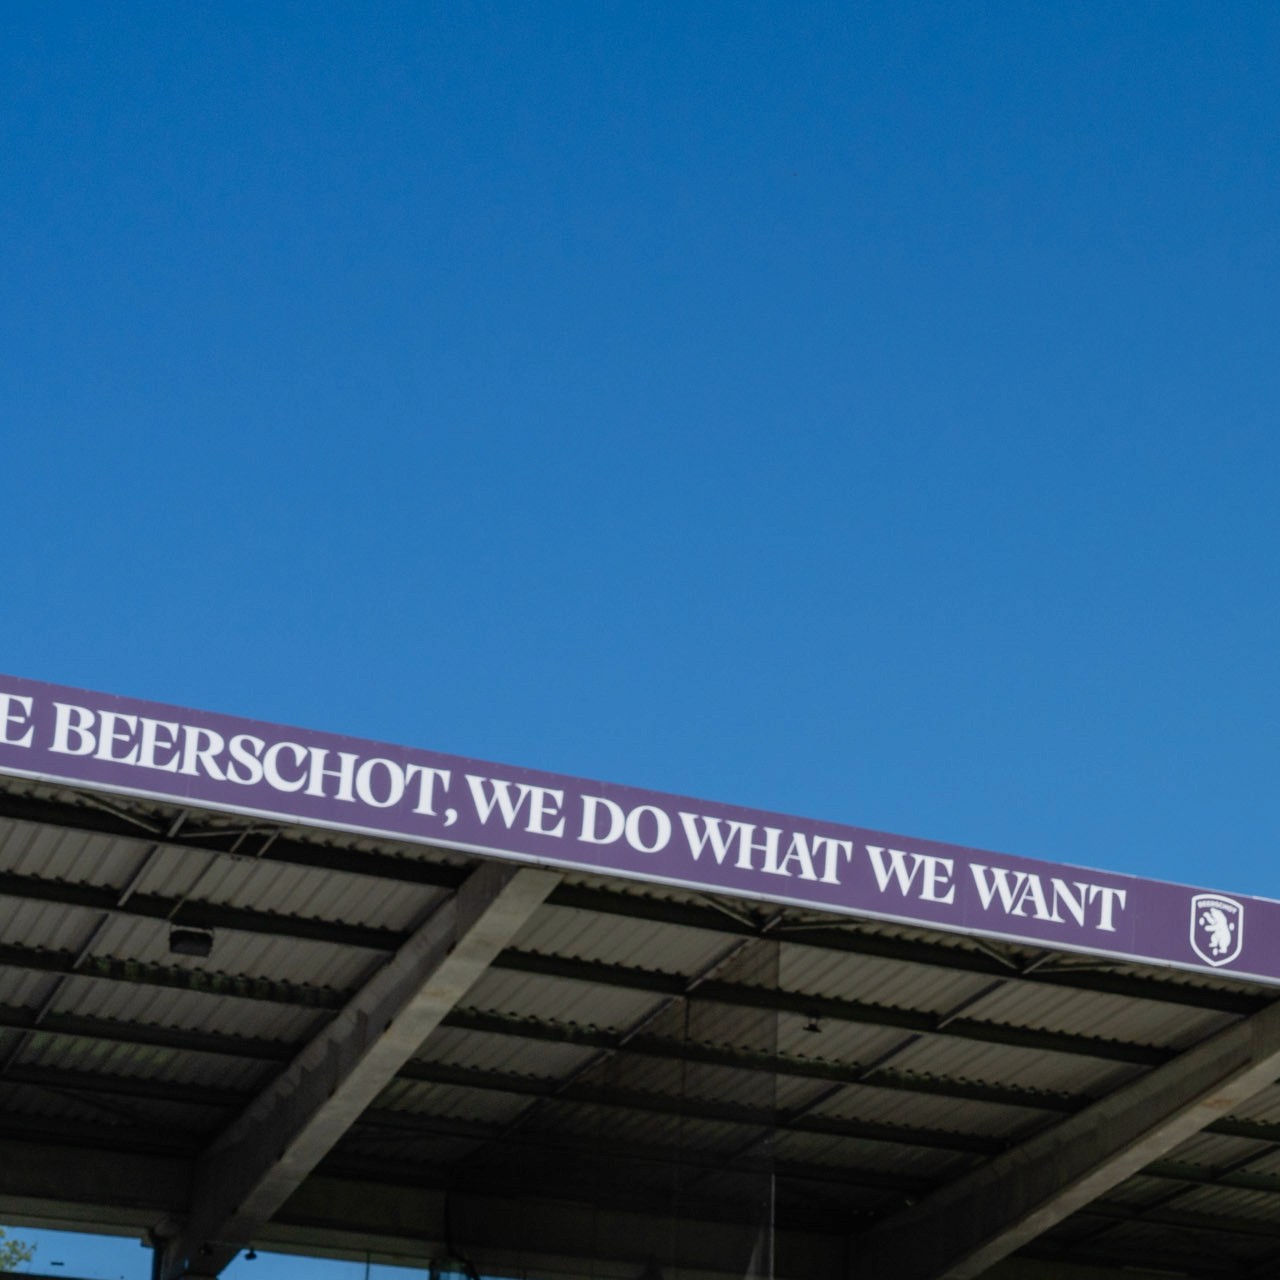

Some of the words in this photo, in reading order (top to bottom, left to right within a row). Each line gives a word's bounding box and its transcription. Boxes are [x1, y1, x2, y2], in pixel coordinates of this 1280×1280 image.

[48, 702, 458, 828] BEERSCHOT,
[464, 774, 566, 838] WE
[577, 795, 672, 854] DO
[679, 812, 852, 886] WHAT
[866, 844, 956, 905] WE
[969, 862, 1127, 932] WANT
